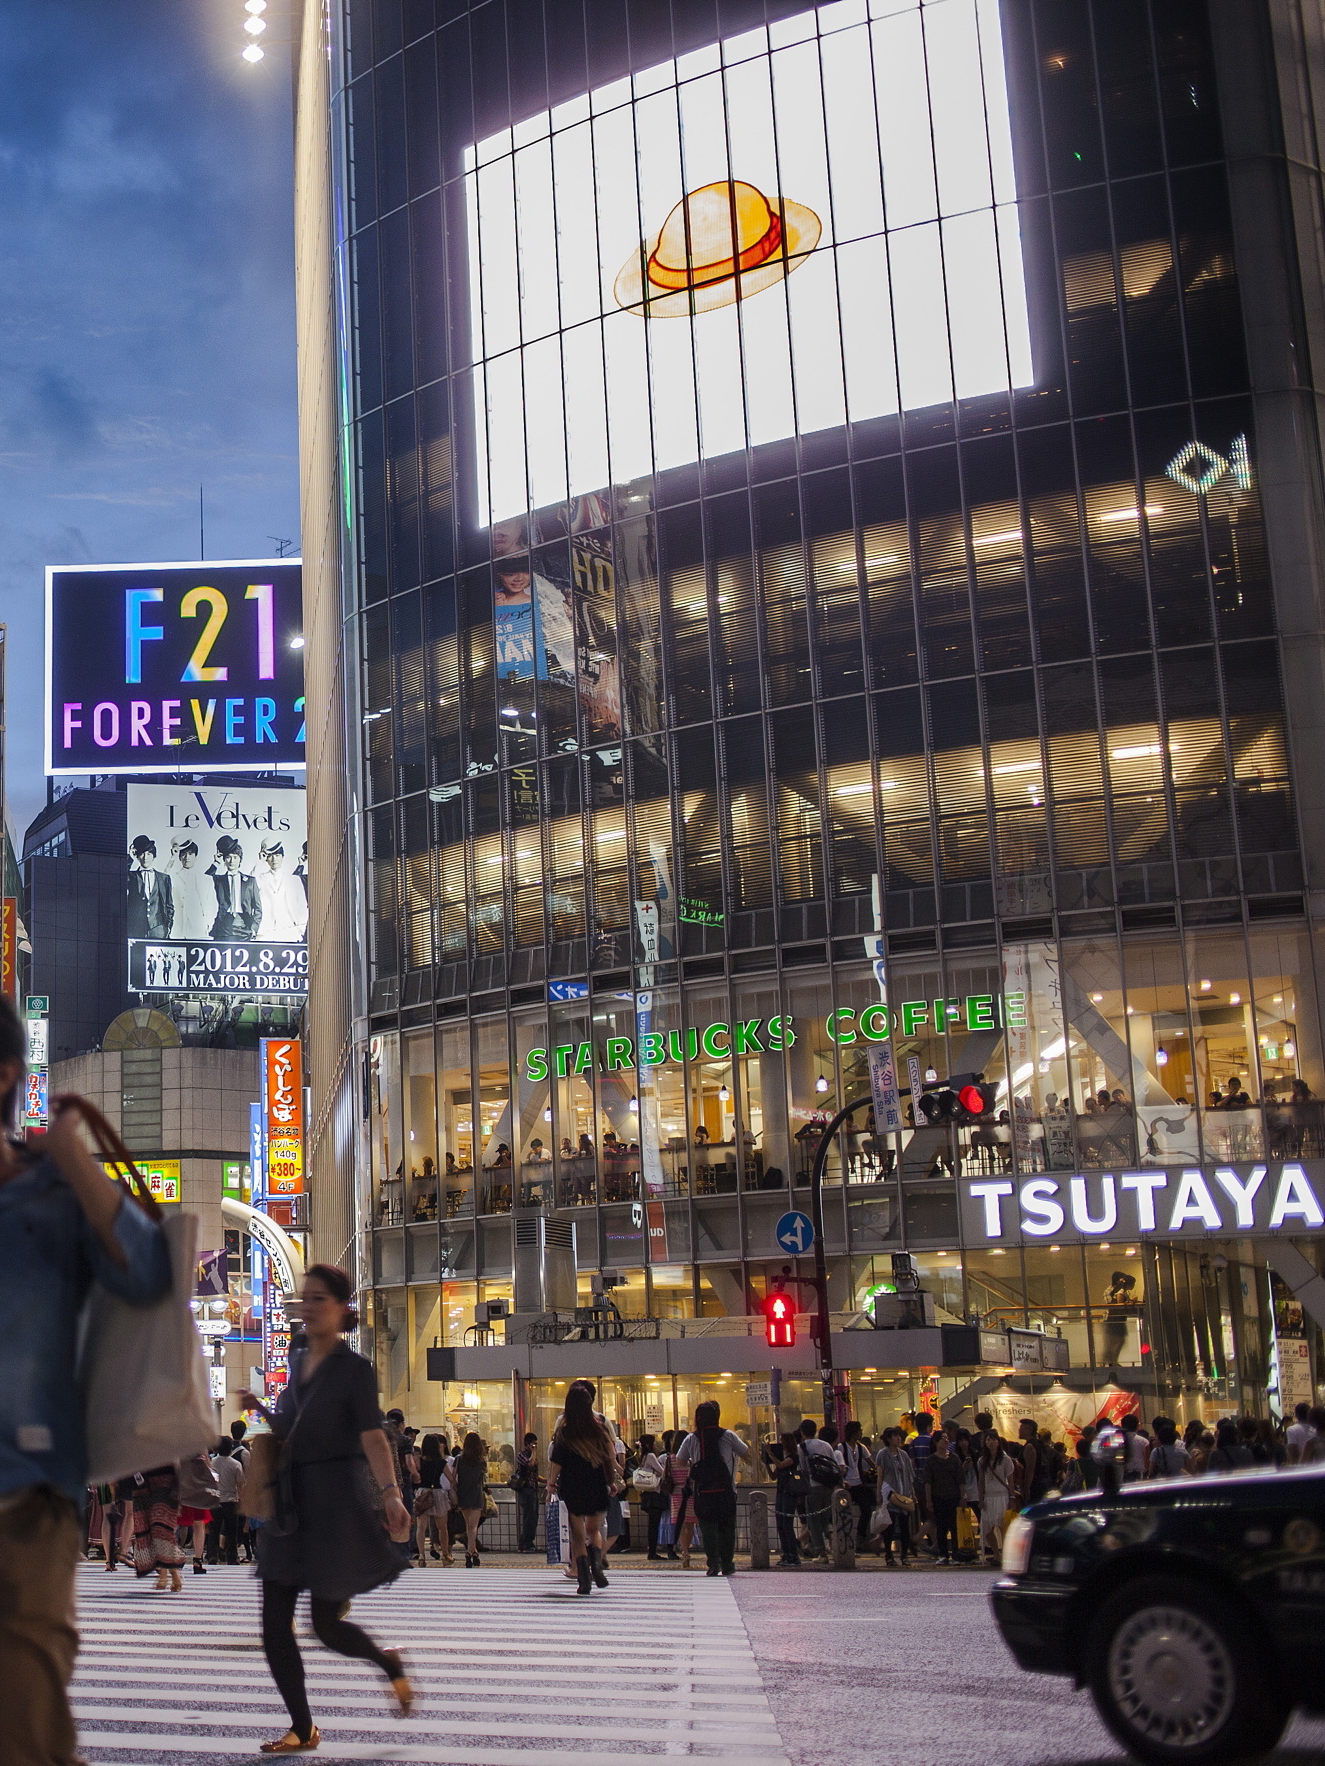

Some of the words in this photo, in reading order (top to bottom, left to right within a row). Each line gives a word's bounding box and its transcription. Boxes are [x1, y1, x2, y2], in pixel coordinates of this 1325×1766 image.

[126, 583, 274, 684] F21
[64, 697, 278, 748] FOREVER
[294, 697, 306, 743] 2
[190, 973, 251, 989] MAJOR
[526, 1014, 798, 1082] STARBUCKS
[826, 990, 1029, 1045] COFFEE
[272, 1044, 297, 1122] くいしんぼ
[878, 1051, 899, 1126] 渋谷駅前
[274, 1151, 297, 1160] 140g
[278, 1182, 294, 1192] 4F
[969, 1162, 1325, 1238] TSUTAYA
